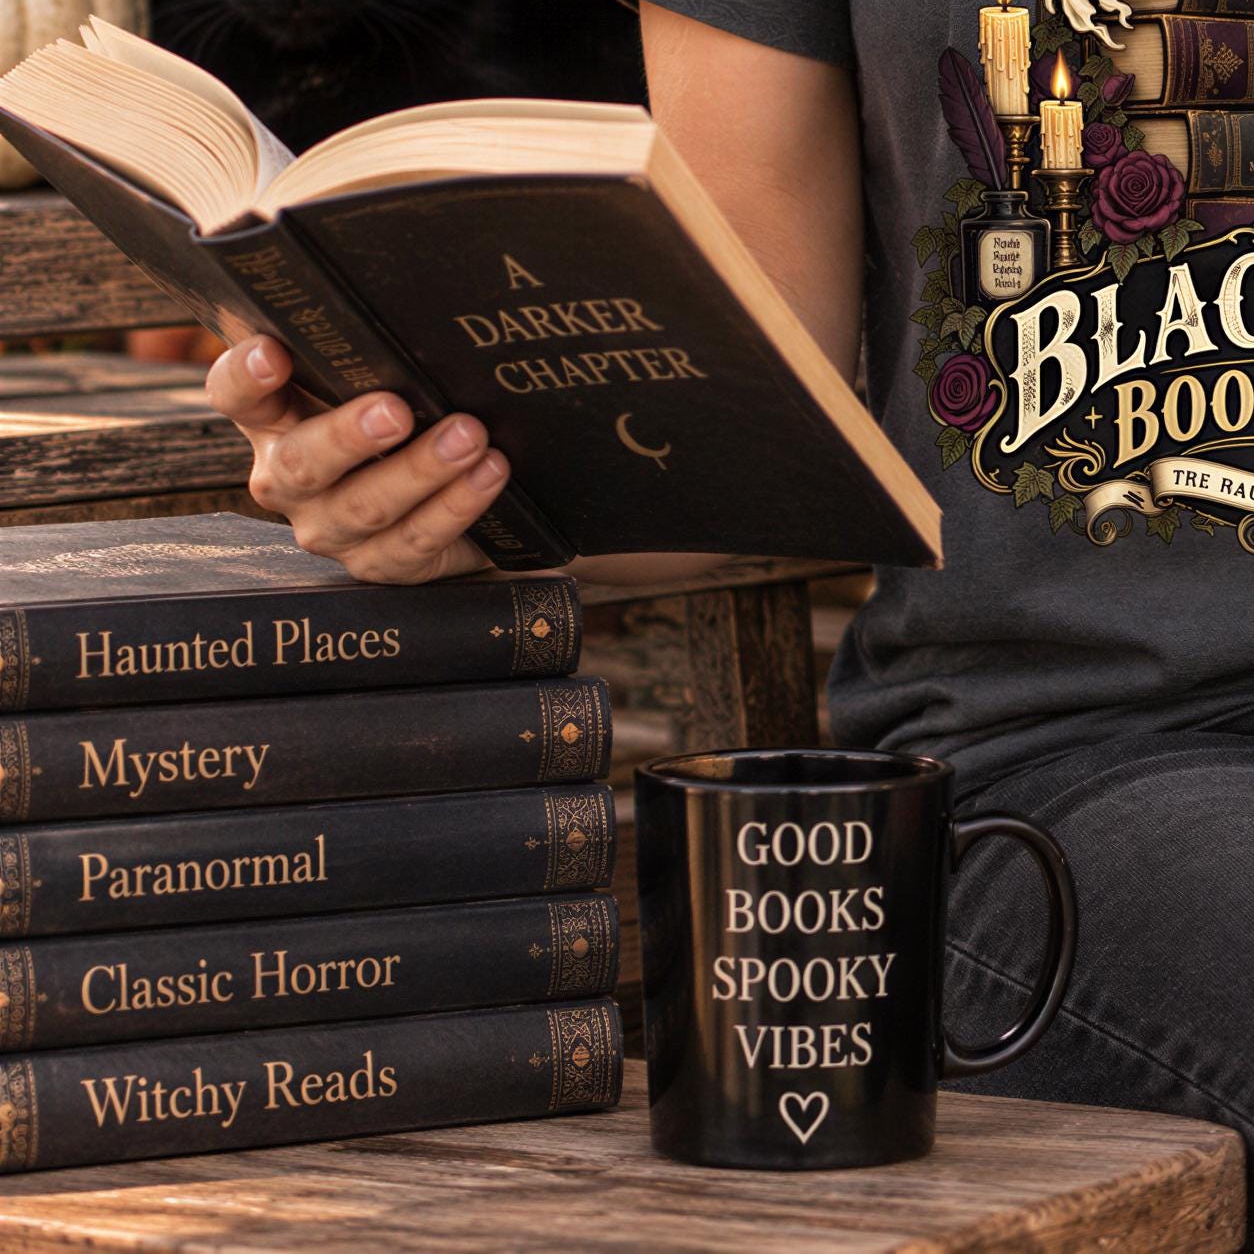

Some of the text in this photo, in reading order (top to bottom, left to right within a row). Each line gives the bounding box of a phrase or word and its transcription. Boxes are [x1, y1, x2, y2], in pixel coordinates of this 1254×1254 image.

[503, 254, 544, 289] A
[454, 298, 664, 347] DARKER
[495, 347, 709, 393] CHAPTER
[75, 618, 400, 678] Haunted Places
[78, 738, 270, 798] Mystery
[737, 821, 872, 866] GOOD
[78, 836, 328, 901] Paranormal
[725, 886, 885, 934] BOOKS
[81, 950, 400, 1014] Classic Horror
[711, 953, 896, 1002] SPOOKY
[733, 1022, 873, 1069] VIBES
[80, 1050, 397, 1128] Witchy Reads
